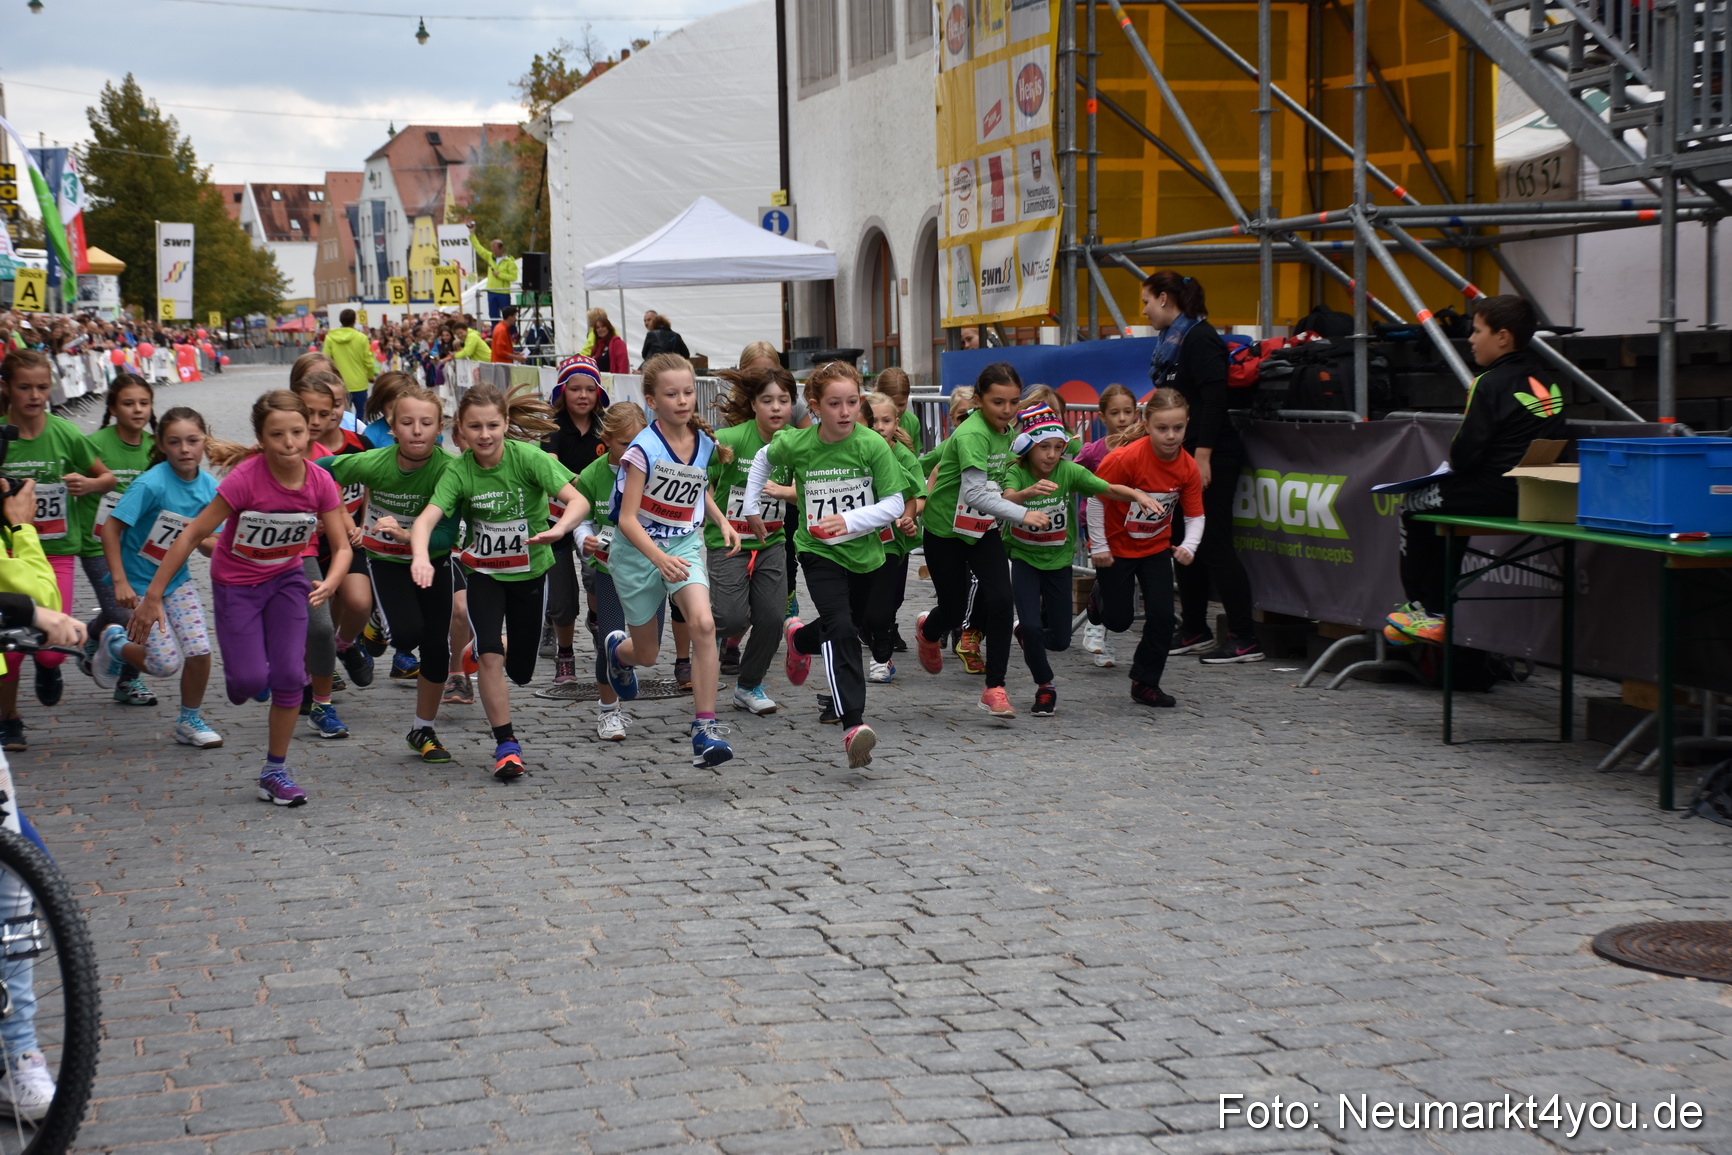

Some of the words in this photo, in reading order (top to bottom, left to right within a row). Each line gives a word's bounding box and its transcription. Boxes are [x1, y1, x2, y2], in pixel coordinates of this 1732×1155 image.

[162, 238, 191, 247] swn
[981, 266, 1001, 287] swn
[21, 281, 38, 302] A
[393, 285, 404, 299] B
[440, 278, 456, 298] A
[162, 304, 172, 315] C
[655, 464, 676, 476] PARTL
[676, 470, 703, 480] Neumarkt
[650, 475, 702, 505] 7026
[806, 488, 828, 497] PARTL
[829, 484, 861, 494] Neumarkt
[36, 496, 60, 518] 85
[650, 502, 683, 519] Theresa
[735, 498, 780, 520] 771
[812, 491, 866, 520] 7131
[1232, 472, 1341, 532] BOCK
[241, 515, 268, 525] PARTL
[484, 524, 516, 533] Neumarkt
[246, 524, 308, 547] 7048
[474, 531, 523, 556] 7044
[1305, 544, 1354, 566] concepts
